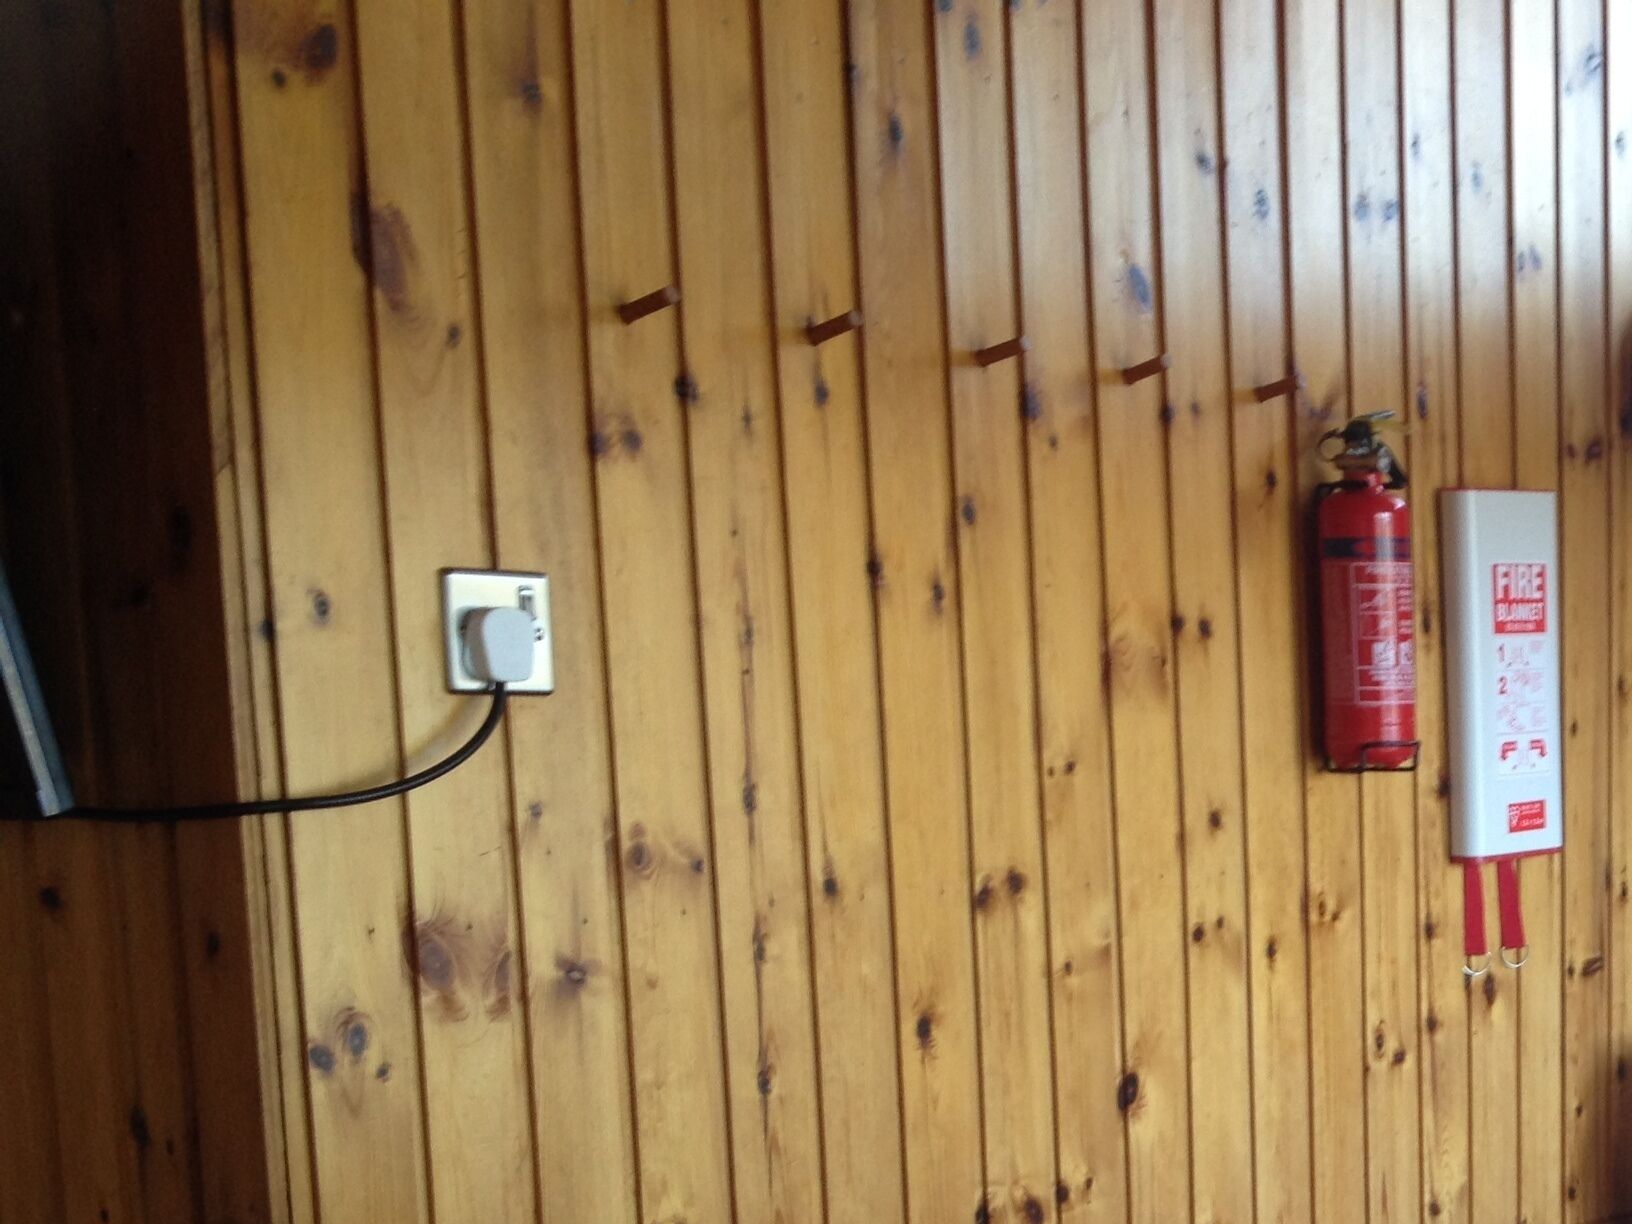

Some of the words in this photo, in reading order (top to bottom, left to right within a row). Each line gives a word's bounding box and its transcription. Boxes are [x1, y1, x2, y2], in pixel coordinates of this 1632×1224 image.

[1495, 565, 1544, 600] FIRE
[1496, 602, 1545, 622] BLANKET
[1498, 643, 1505, 662] 1
[1498, 676, 1508, 695] 2
